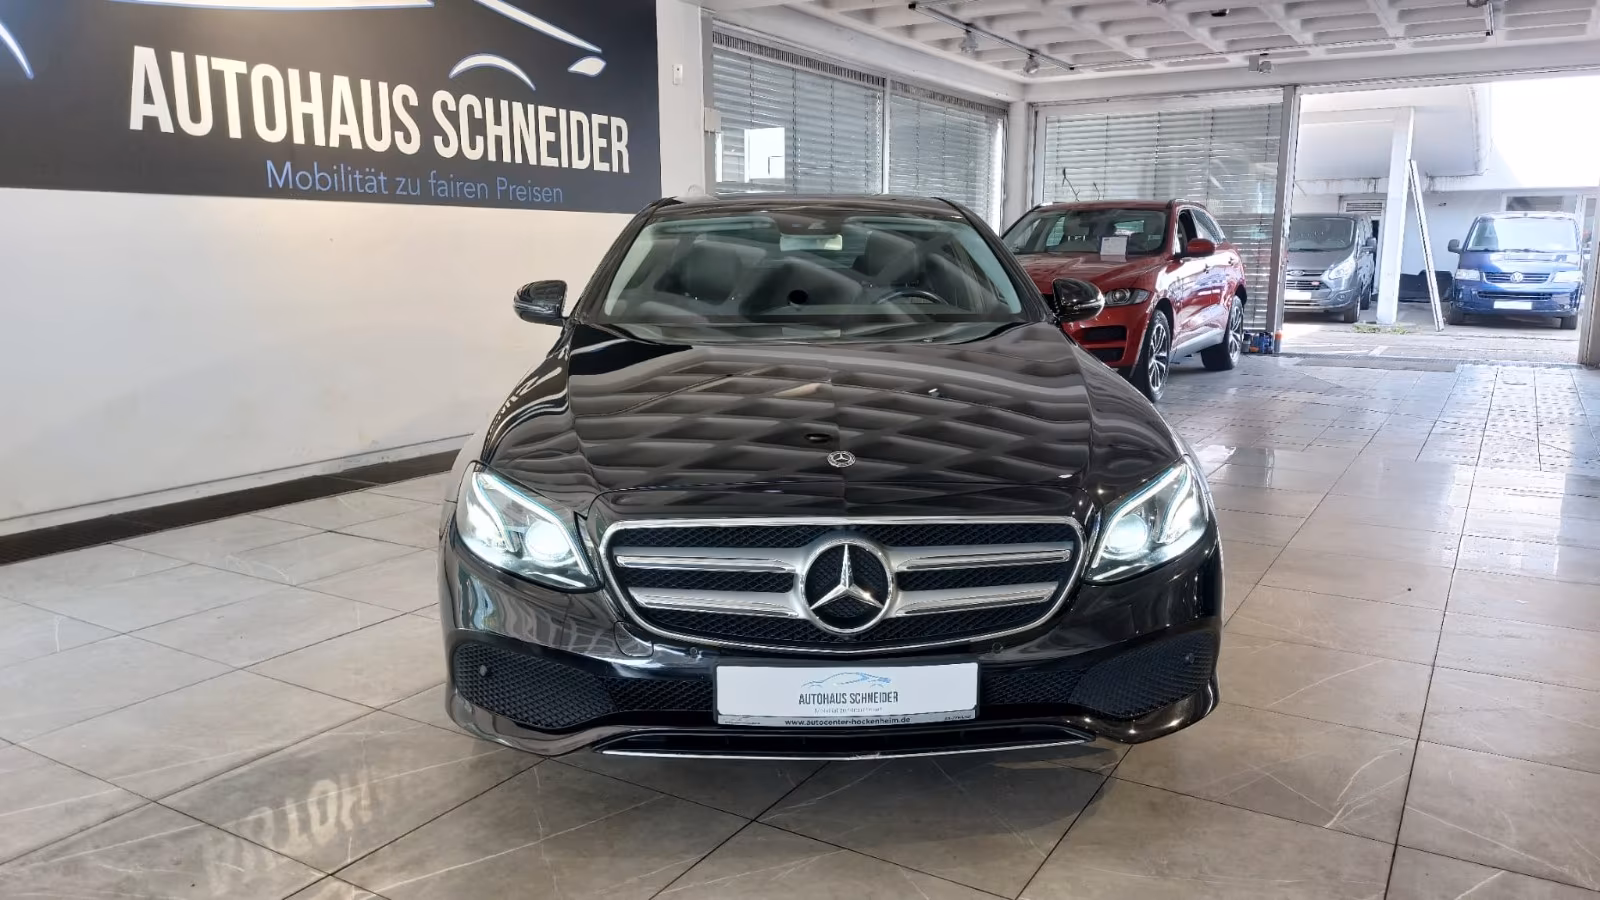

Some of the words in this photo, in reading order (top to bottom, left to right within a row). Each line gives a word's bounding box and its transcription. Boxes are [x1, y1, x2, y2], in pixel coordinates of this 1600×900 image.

[129, 46, 421, 155] AUTOHAUS
[432, 91, 630, 173] SCHNEIDER
[265, 160, 390, 195] Mobilität
[394, 177, 422, 196] zu
[428, 170, 489, 200] fairen
[496, 178, 563, 203] Preisen
[799, 693, 847, 705] AUTOHAUS
[850, 691, 898, 704] SCHNEIDER
[785, 717, 911, 726] www.autocenter-hockenheim.de
